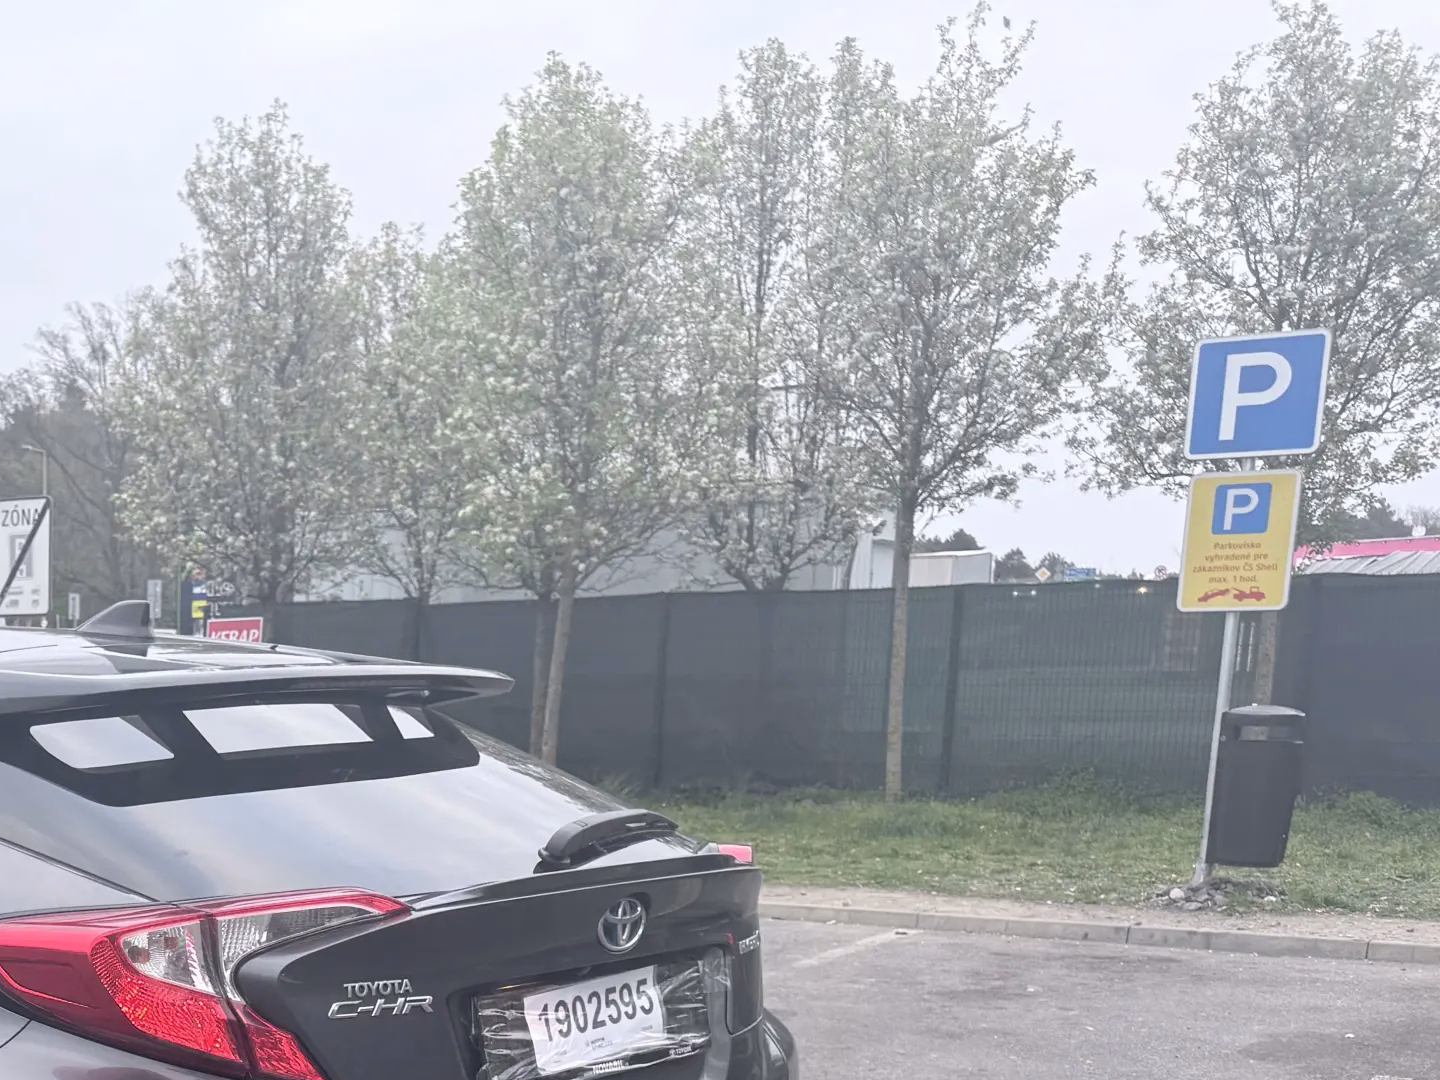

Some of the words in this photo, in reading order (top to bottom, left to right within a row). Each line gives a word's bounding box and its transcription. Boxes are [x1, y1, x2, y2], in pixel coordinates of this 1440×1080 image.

[1218, 351, 1293, 441] P
[1, 504, 43, 527] ZÓNA
[1223, 488, 1259, 531] P
[1253, 552, 1269, 560] pre
[1255, 563, 1278, 571] Shell
[343, 978, 413, 998] TOYOTA
[327, 995, 434, 1019] C-HR
[538, 977, 654, 1042] 1902595
